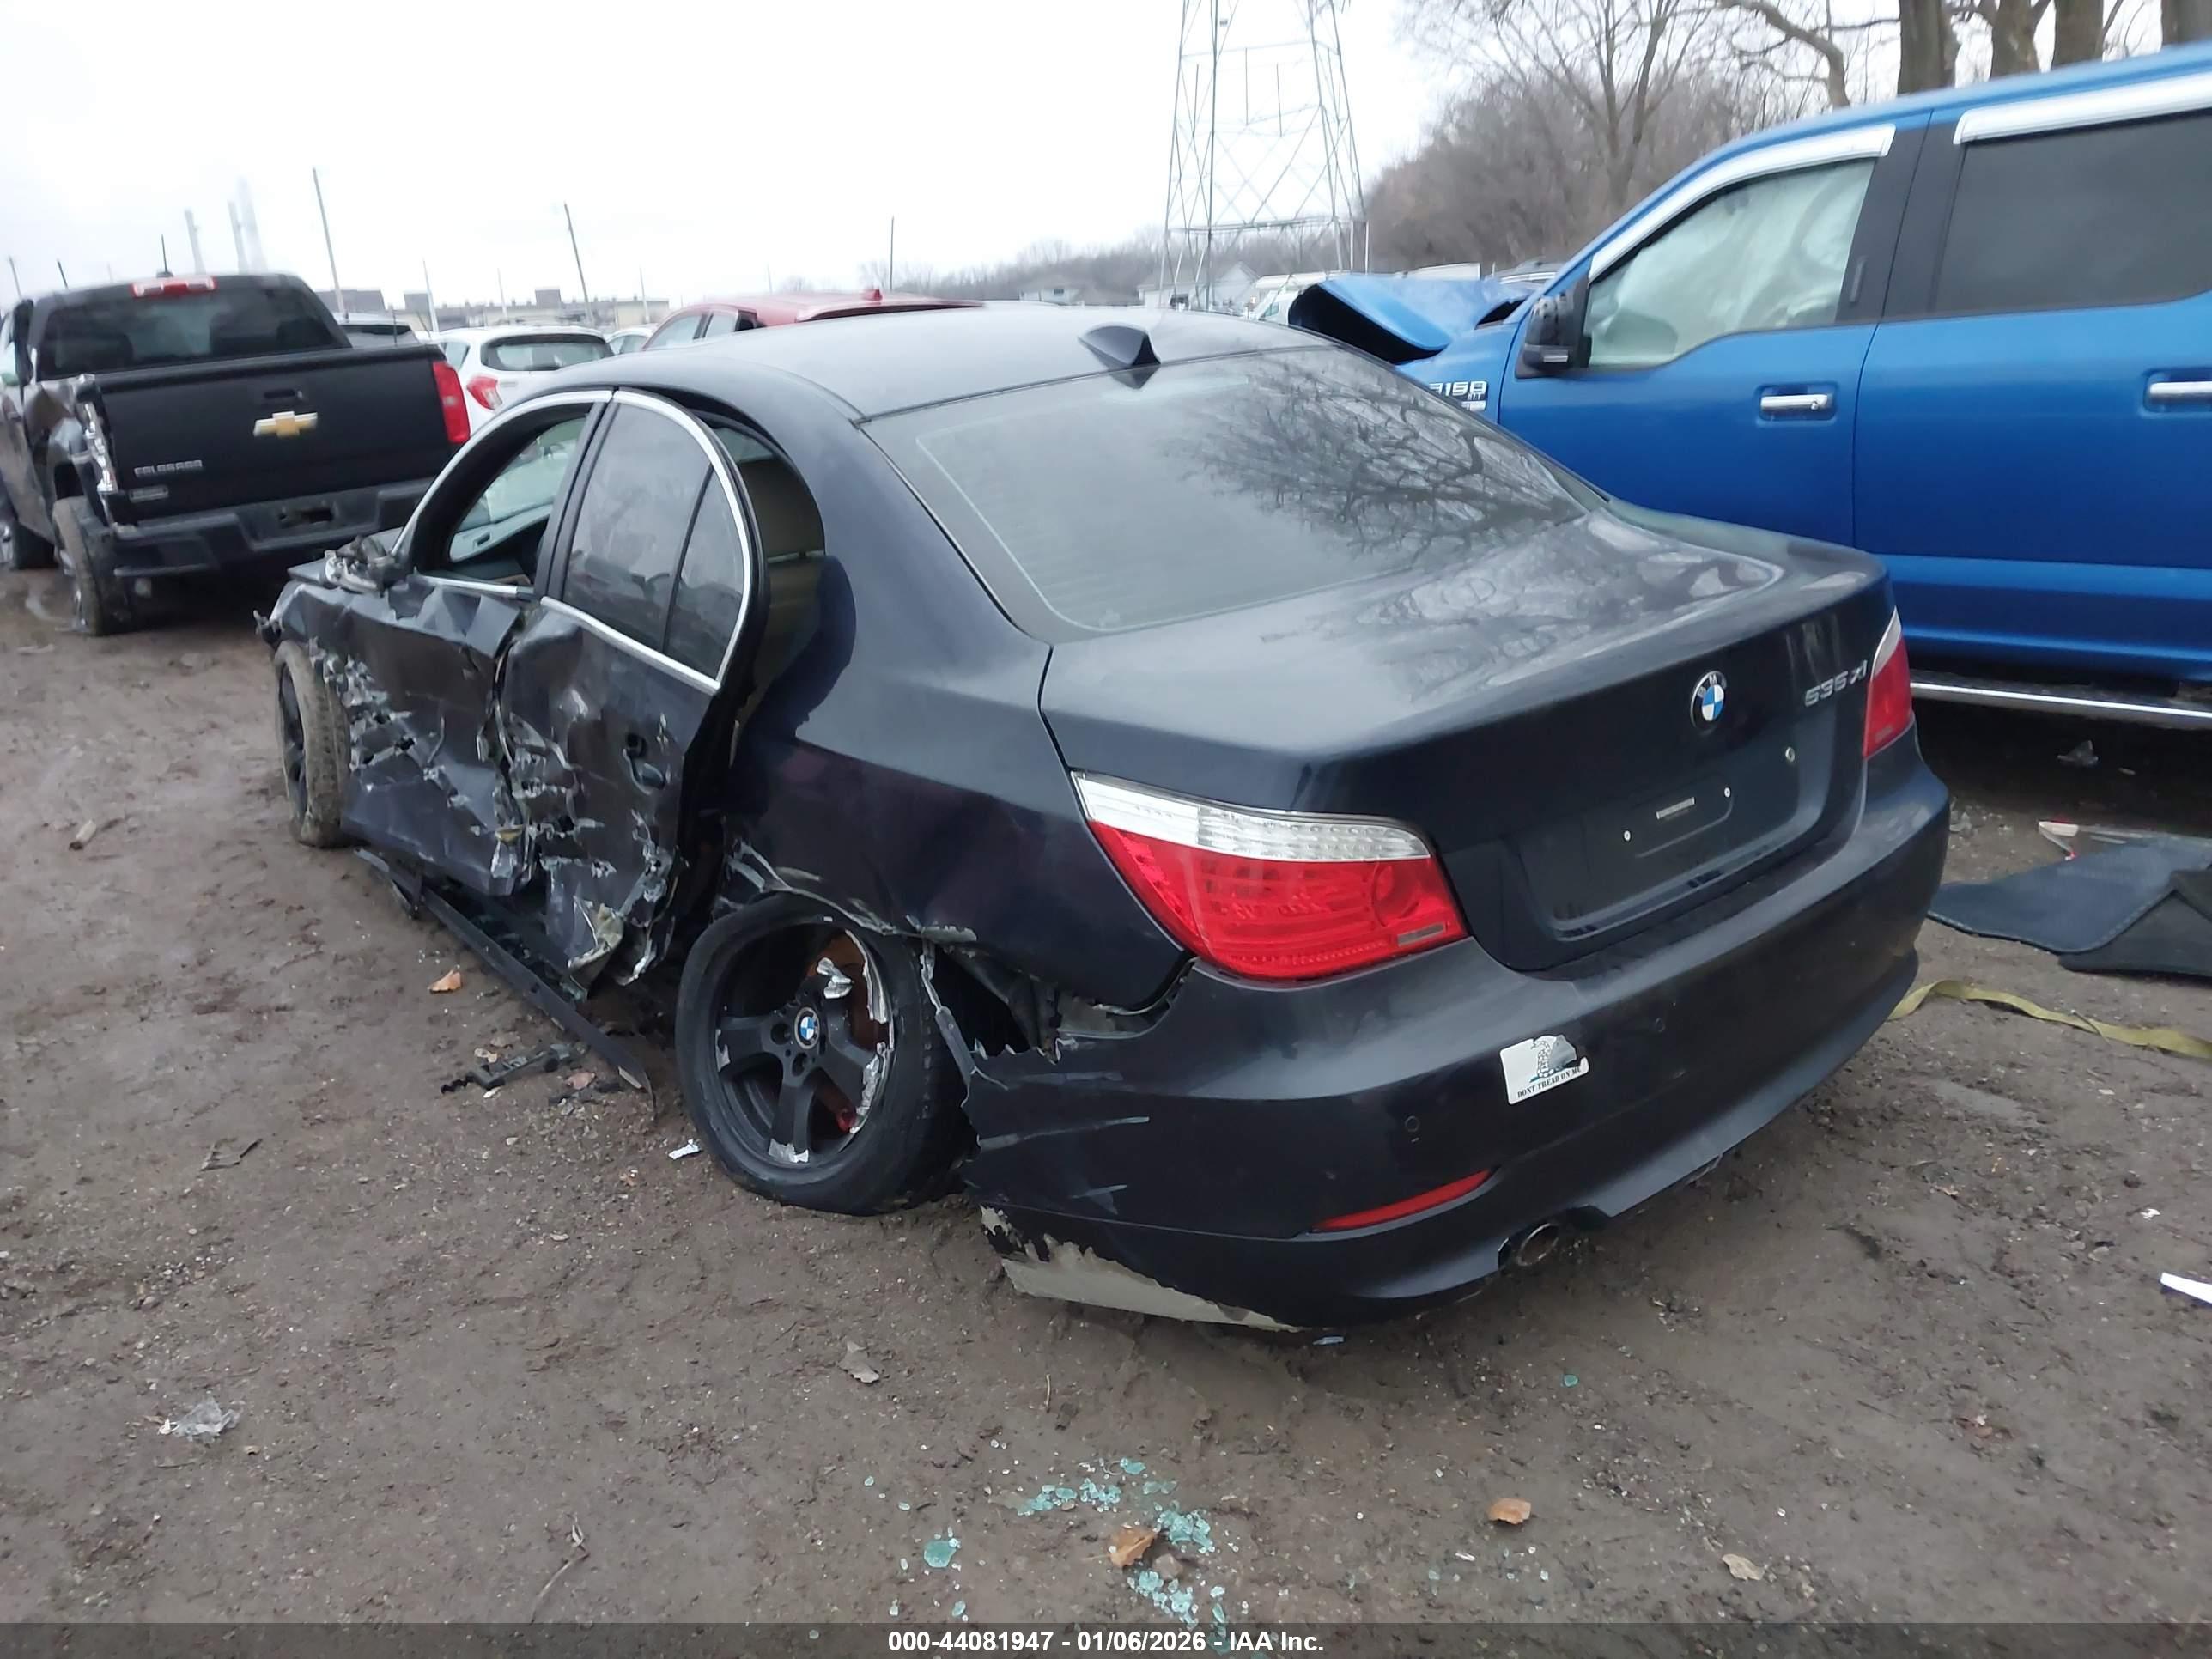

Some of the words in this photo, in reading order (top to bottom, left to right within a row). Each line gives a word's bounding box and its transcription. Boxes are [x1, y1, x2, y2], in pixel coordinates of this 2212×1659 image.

[1516, 1085, 1537, 1098] DONT
[1537, 1074, 1560, 1091] TREAD
[1560, 1070, 1571, 1080] ON
